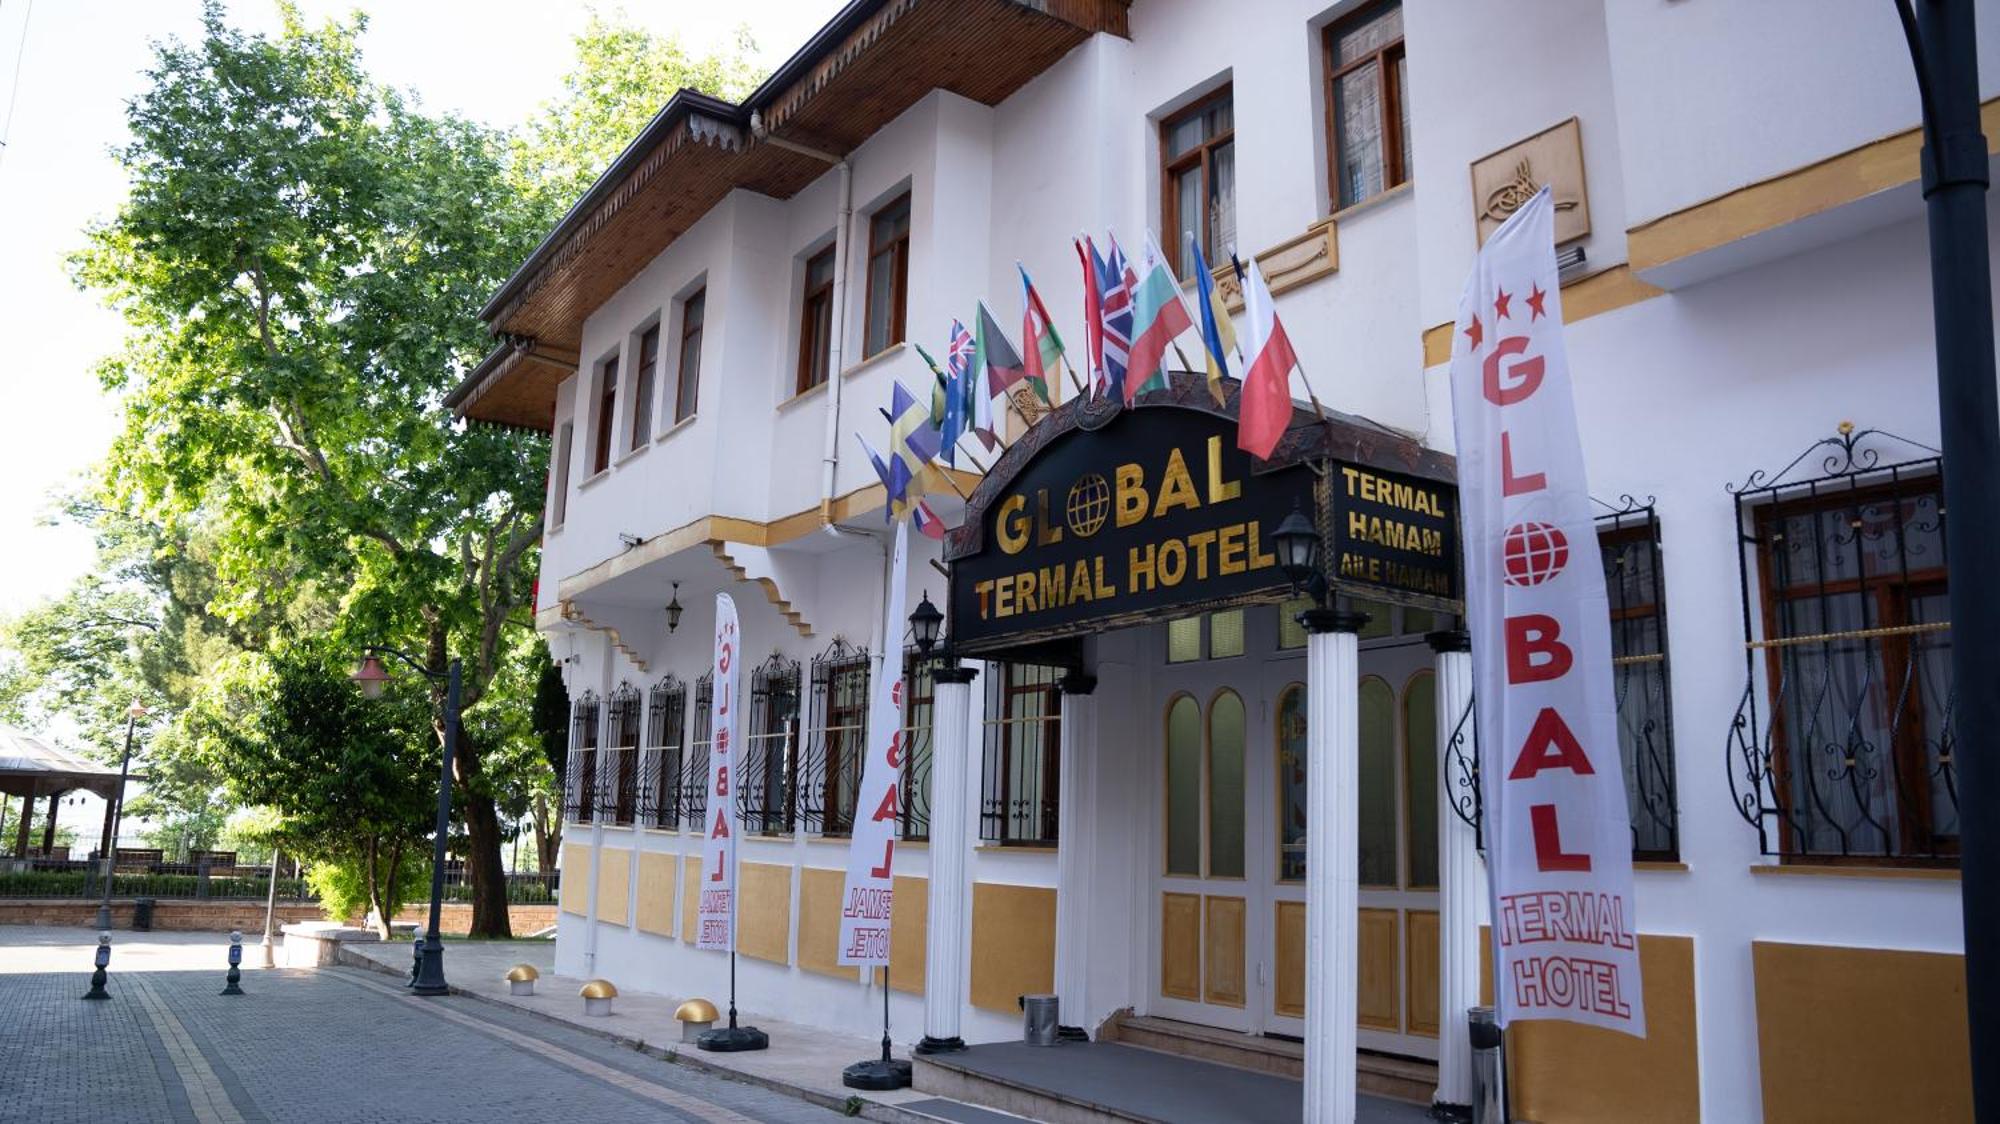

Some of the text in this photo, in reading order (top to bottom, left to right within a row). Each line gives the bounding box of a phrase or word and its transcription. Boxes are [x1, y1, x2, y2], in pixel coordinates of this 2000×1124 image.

[996, 435, 1242, 555] GLOBAL
[1341, 466, 1446, 518] TERMAL
[1348, 511, 1442, 556] HAMAM
[975, 520, 1277, 620] TERMAL HOTEL
[1386, 560, 1449, 593] HAMAM
[1500, 892, 1634, 950] TERMAL
[1513, 956, 1631, 1019] HOTEL
